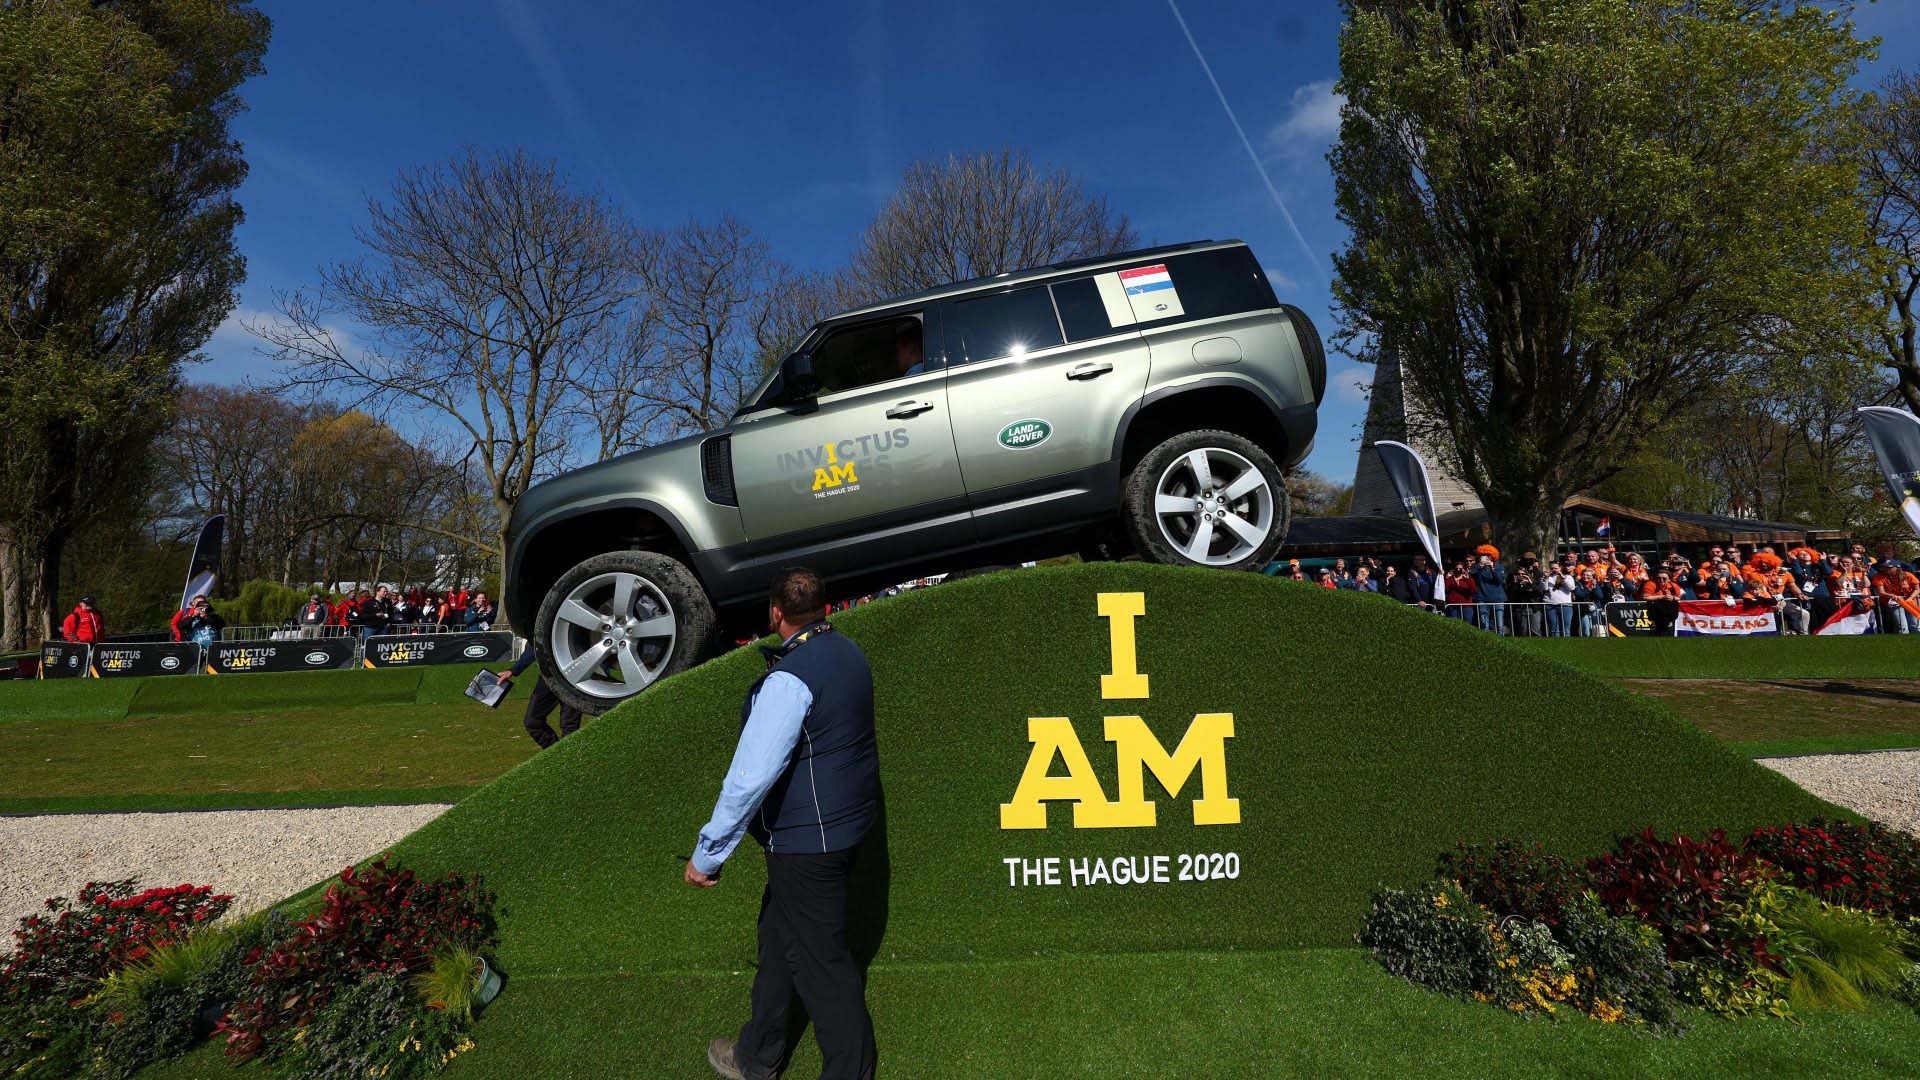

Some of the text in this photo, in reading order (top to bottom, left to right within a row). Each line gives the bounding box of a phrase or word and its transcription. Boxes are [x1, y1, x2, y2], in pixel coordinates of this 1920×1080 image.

[1008, 424, 1034, 436] LAND
[1012, 430, 1044, 444] ROVER
[777, 427, 910, 472] INVICTUS
[814, 491, 826, 500] THE
[1619, 609, 1649, 619] INVI
[1682, 617, 1770, 630] HOLLAND
[377, 641, 435, 652] INVICTUS
[1097, 592, 1149, 699] I
[100, 650, 141, 660] INVICTUS
[220, 647, 277, 658] INVICTUS
[380, 651, 425, 661] GAMES
[102, 659, 133, 668] GAMES
[222, 657, 266, 667] GAMES
[1000, 712, 1241, 829] AM
[1003, 852, 1240, 887] THE HAGUE 2020
